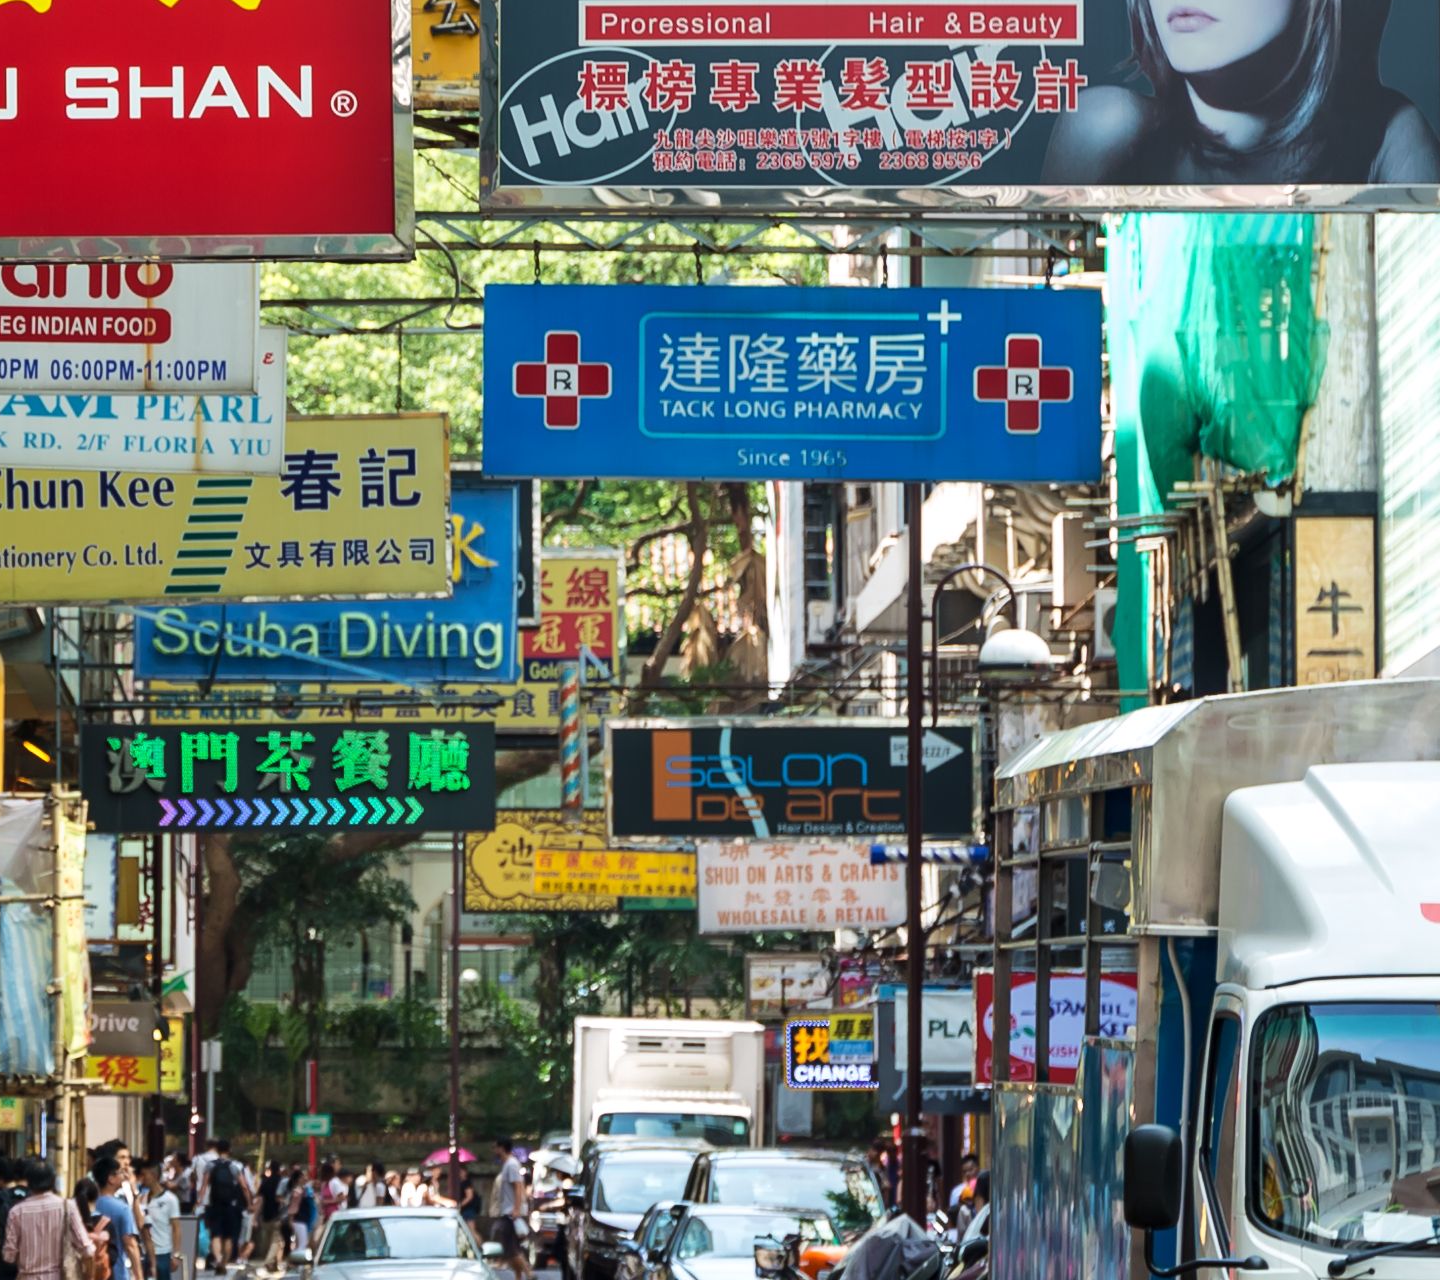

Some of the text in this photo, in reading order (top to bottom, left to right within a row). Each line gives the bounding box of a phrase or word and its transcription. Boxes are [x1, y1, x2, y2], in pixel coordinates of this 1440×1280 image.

[869, 12, 1064, 39] Hair & Beauty
[65, 64, 315, 120] SHAN
[577, 57, 1088, 114] 標榜專業髮型設計
[756, 151, 984, 170] 2365 5975 2368 9556
[30, 315, 98, 337] INDIAN
[101, 316, 158, 338] FOOD
[50, 358, 228, 383] 06:00PM-11:00PM
[658, 331, 929, 396] 達隆藥房
[134, 395, 273, 426] PEARL
[659, 401, 924, 422] TACK LONG PHARMACY
[22, 431, 62, 451] RD.
[77, 432, 110, 452] 2/F
[122, 435, 215, 456] FLORIA
[229, 437, 272, 458] YIU
[737, 449, 849, 468] Since 1965
[98, 468, 175, 509] Kee
[280, 447, 422, 512] 春記
[82, 545, 121, 568] Co.
[124, 542, 164, 568] Ltd.
[244, 537, 437, 571] 文具有限公司
[152, 607, 505, 670] Scuba Diving
[106, 729, 472, 794] 澳門茶餐廳
[777, 822, 801, 834] Hair
[747, 864, 767, 885] ON
[774, 864, 815, 884] ARTS
[716, 907, 888, 927] WHOLESALE RETAIL
[792, 1063, 872, 1083] CHANGE
